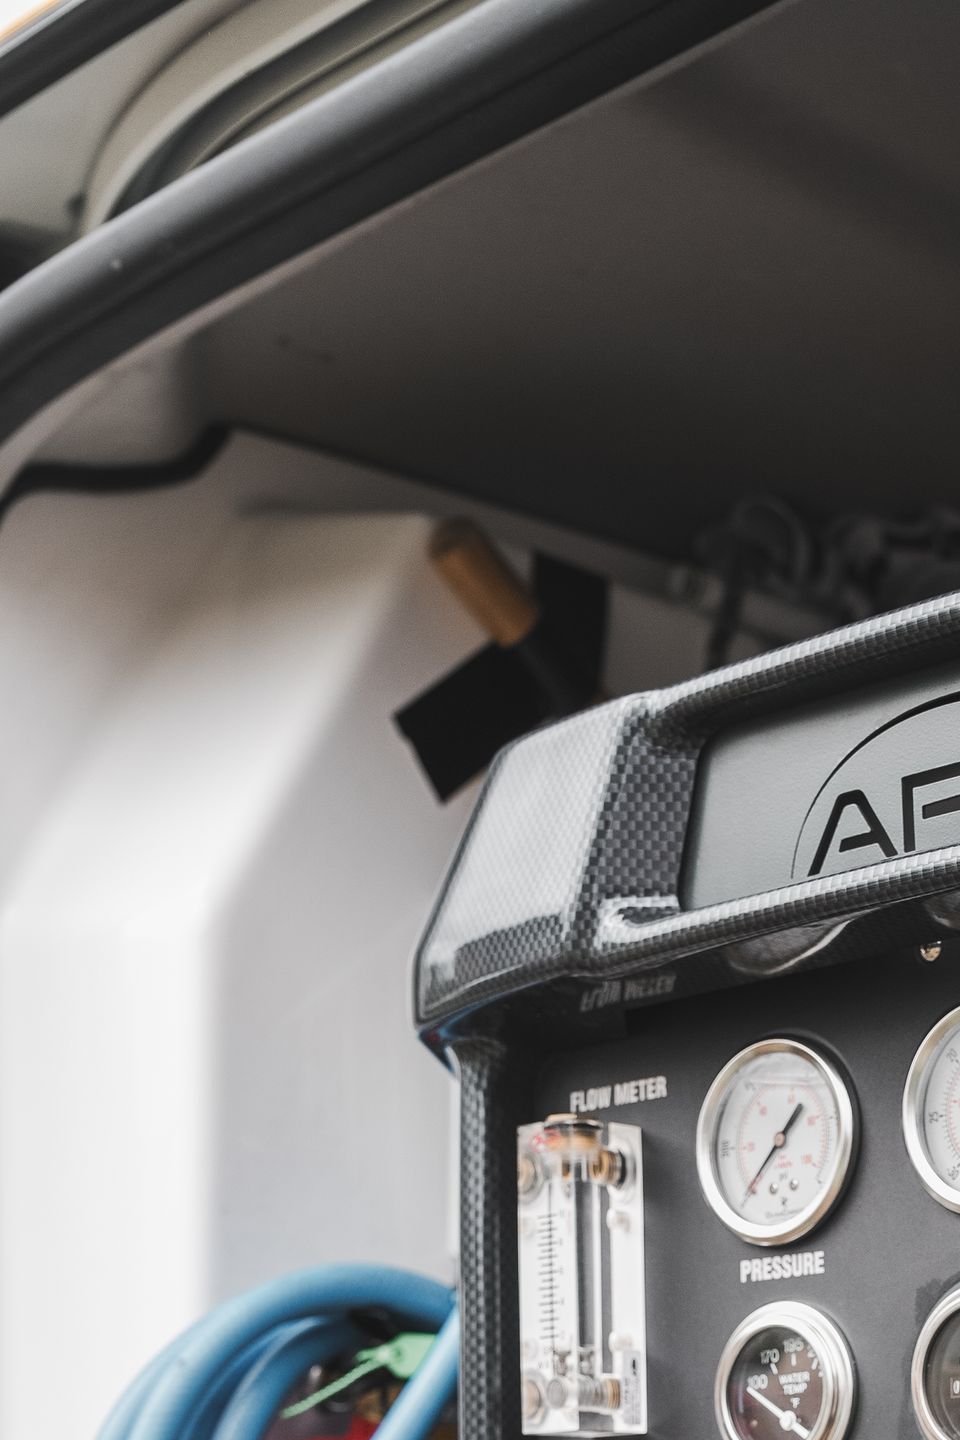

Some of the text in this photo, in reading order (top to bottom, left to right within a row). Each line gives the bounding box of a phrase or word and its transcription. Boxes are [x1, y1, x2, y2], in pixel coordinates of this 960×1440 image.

[569, 1075, 668, 1113] FLOW METER
[739, 1250, 826, 1284] PRESSURE
